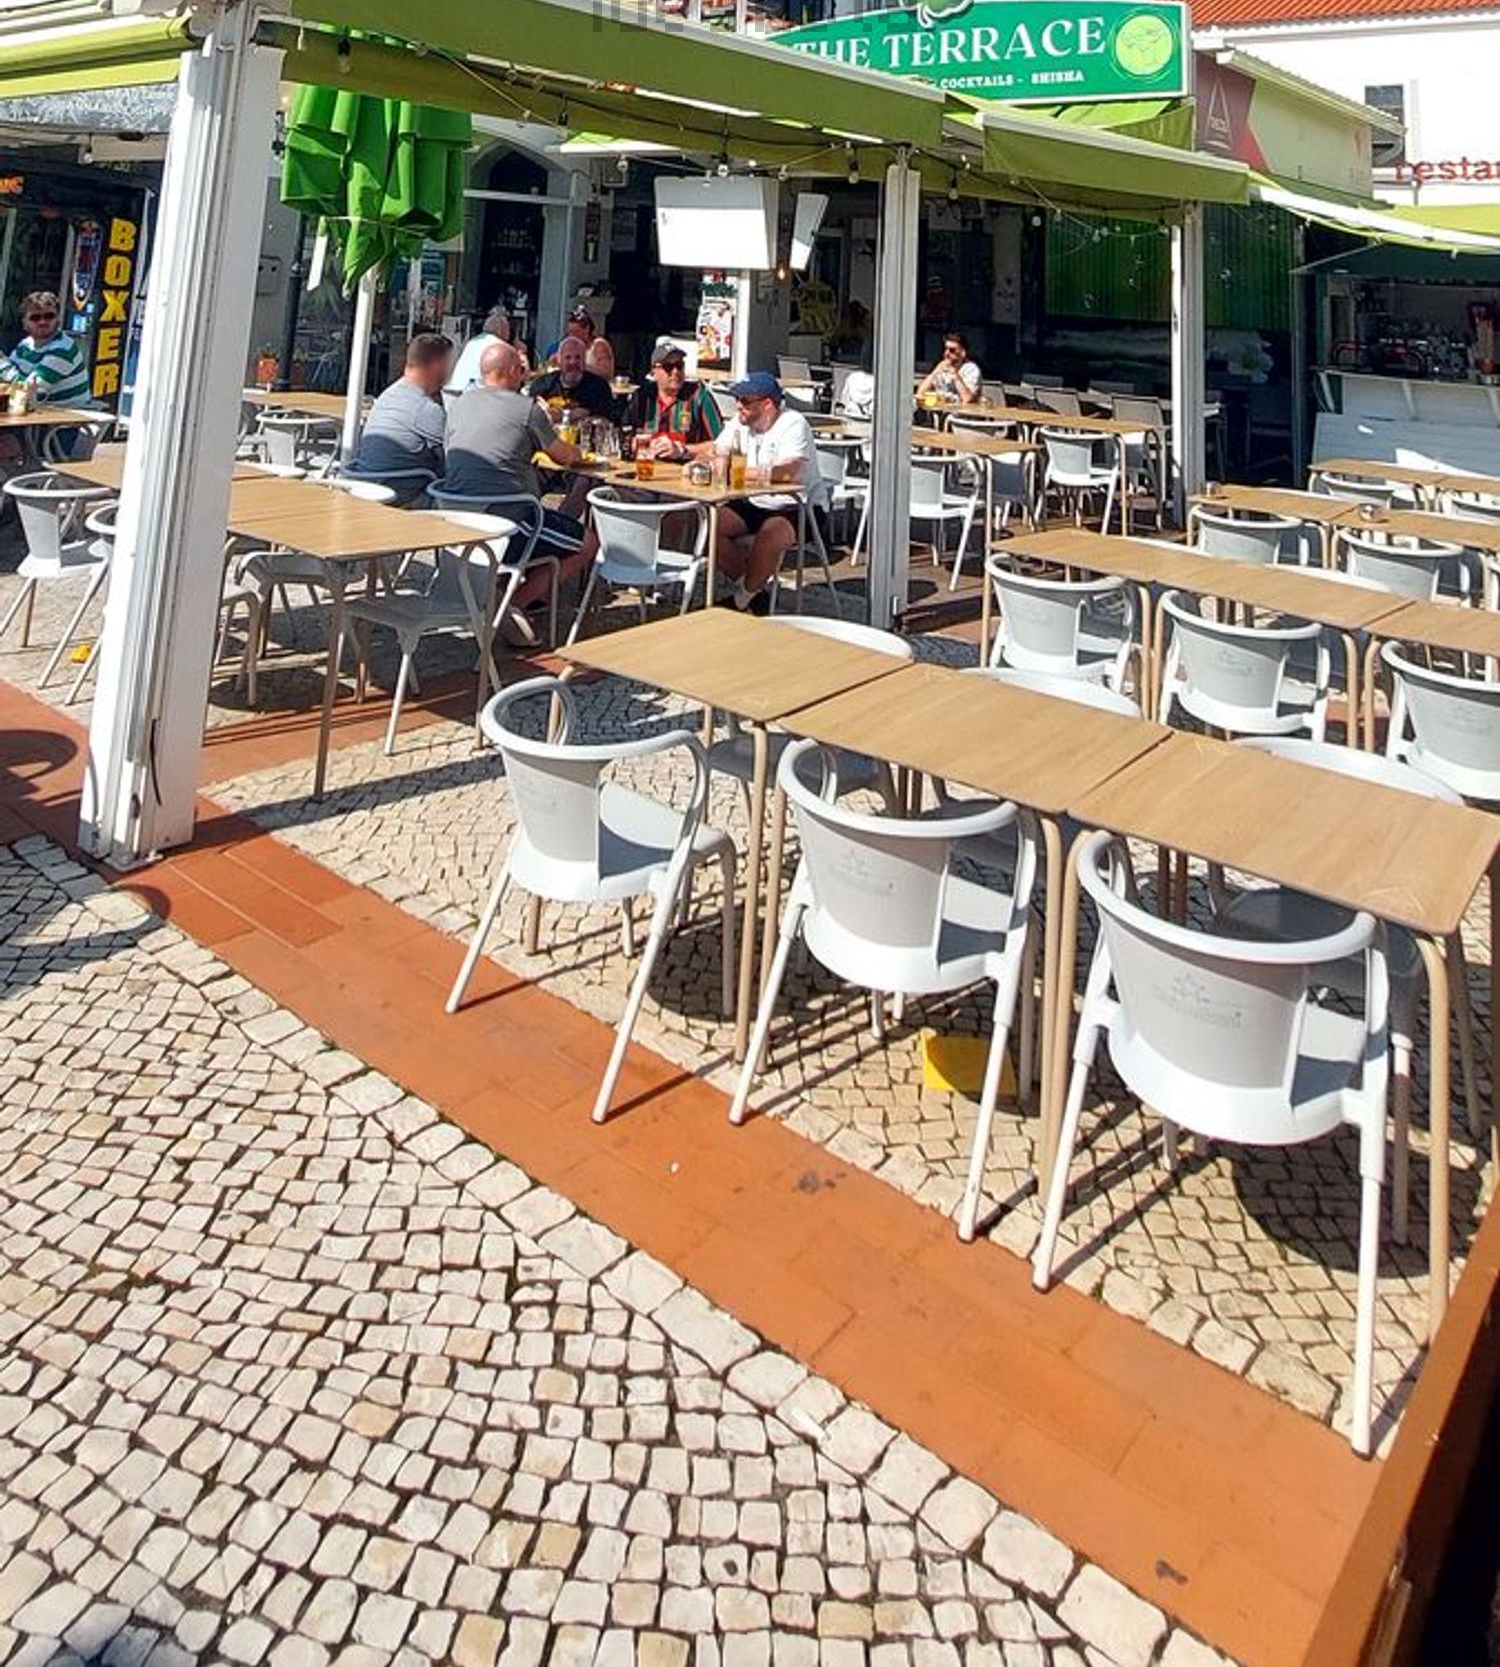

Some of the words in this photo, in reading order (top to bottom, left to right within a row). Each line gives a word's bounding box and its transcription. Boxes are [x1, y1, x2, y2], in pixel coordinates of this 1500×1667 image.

[882, 16, 1106, 68] TERRACE
[940, 74, 1014, 89] COCKTAILS
[1031, 69, 1085, 85] SHISHA
[92, 218, 137, 398] BOXER
